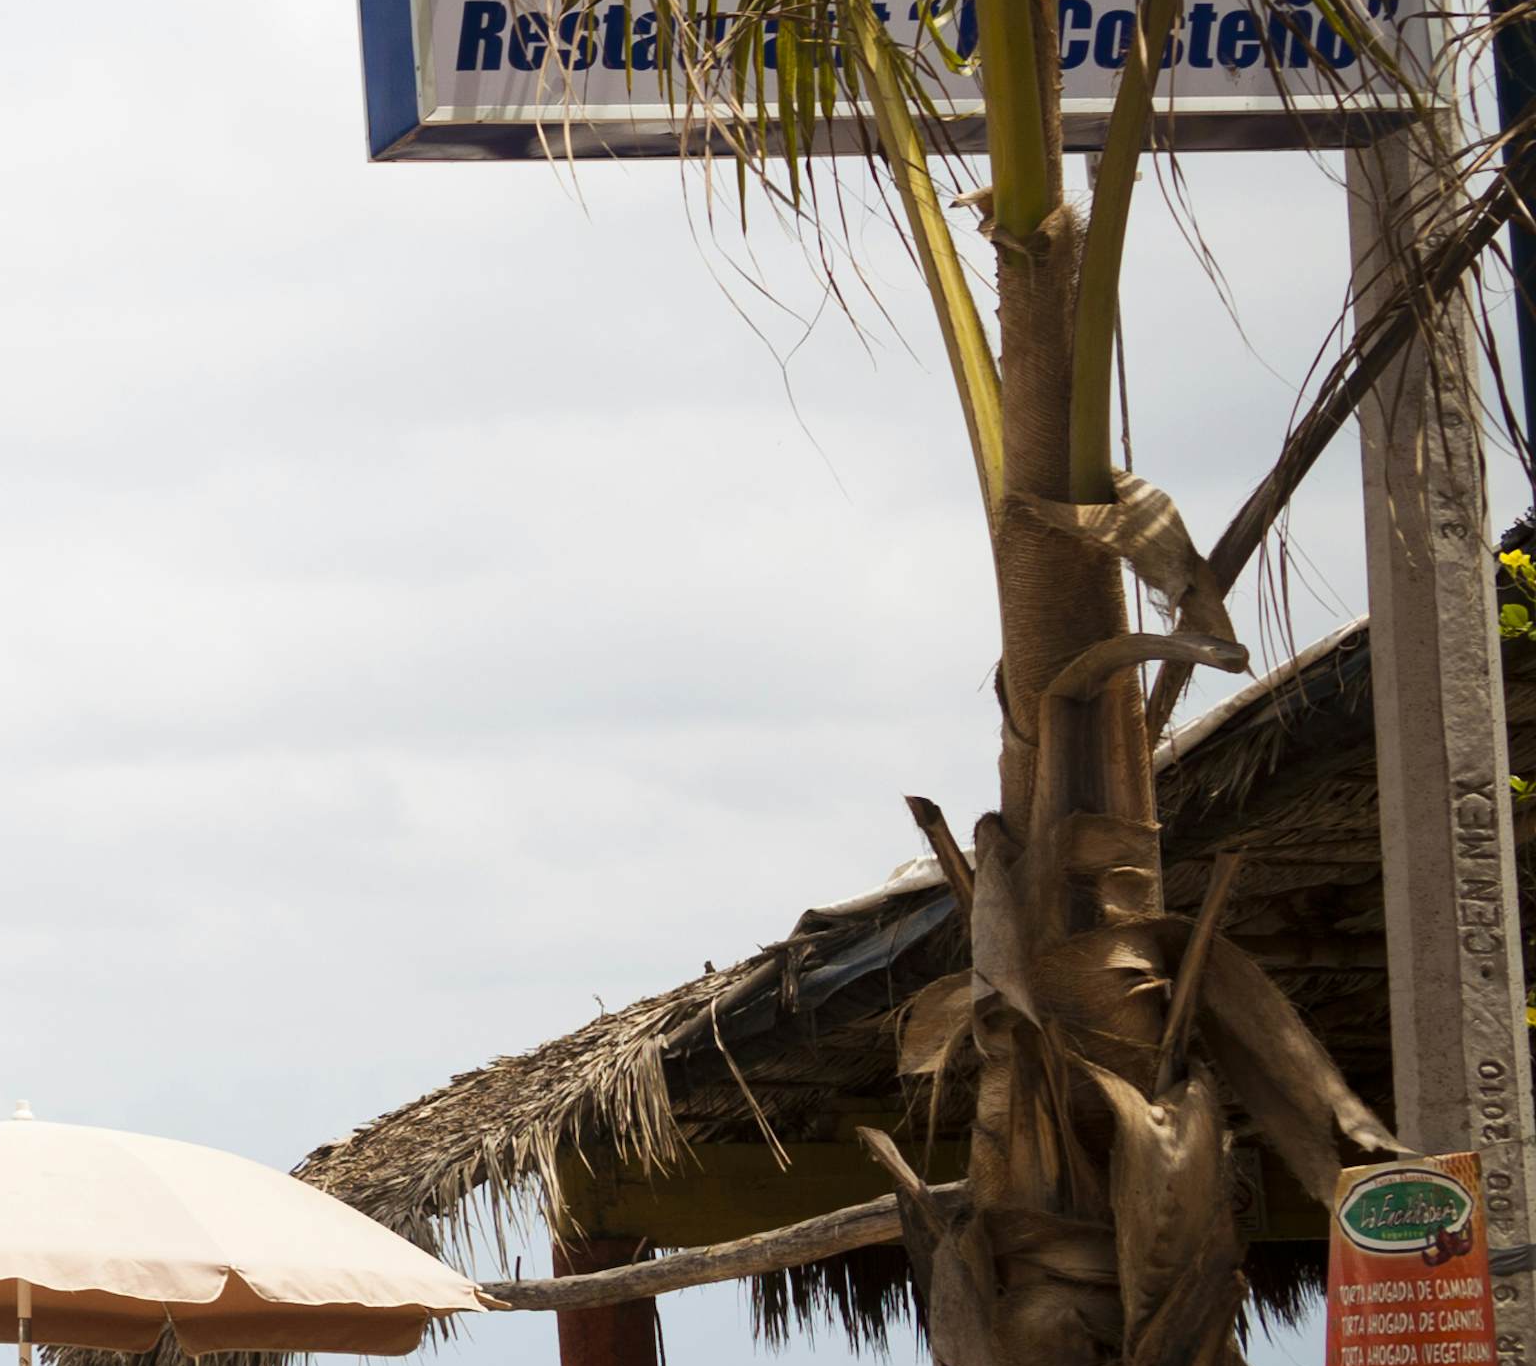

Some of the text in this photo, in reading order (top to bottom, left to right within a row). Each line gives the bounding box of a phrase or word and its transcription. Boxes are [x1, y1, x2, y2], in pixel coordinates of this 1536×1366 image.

[1477, 1060, 1510, 1143] 2010
[1367, 1281, 1415, 1303] AHOGADA
[1418, 1280, 1433, 1300] DE
[1368, 1313, 1415, 1334] AHOGADA
[1419, 1312, 1434, 1332] DE
[1367, 1344, 1419, 1366] AHOGADA
